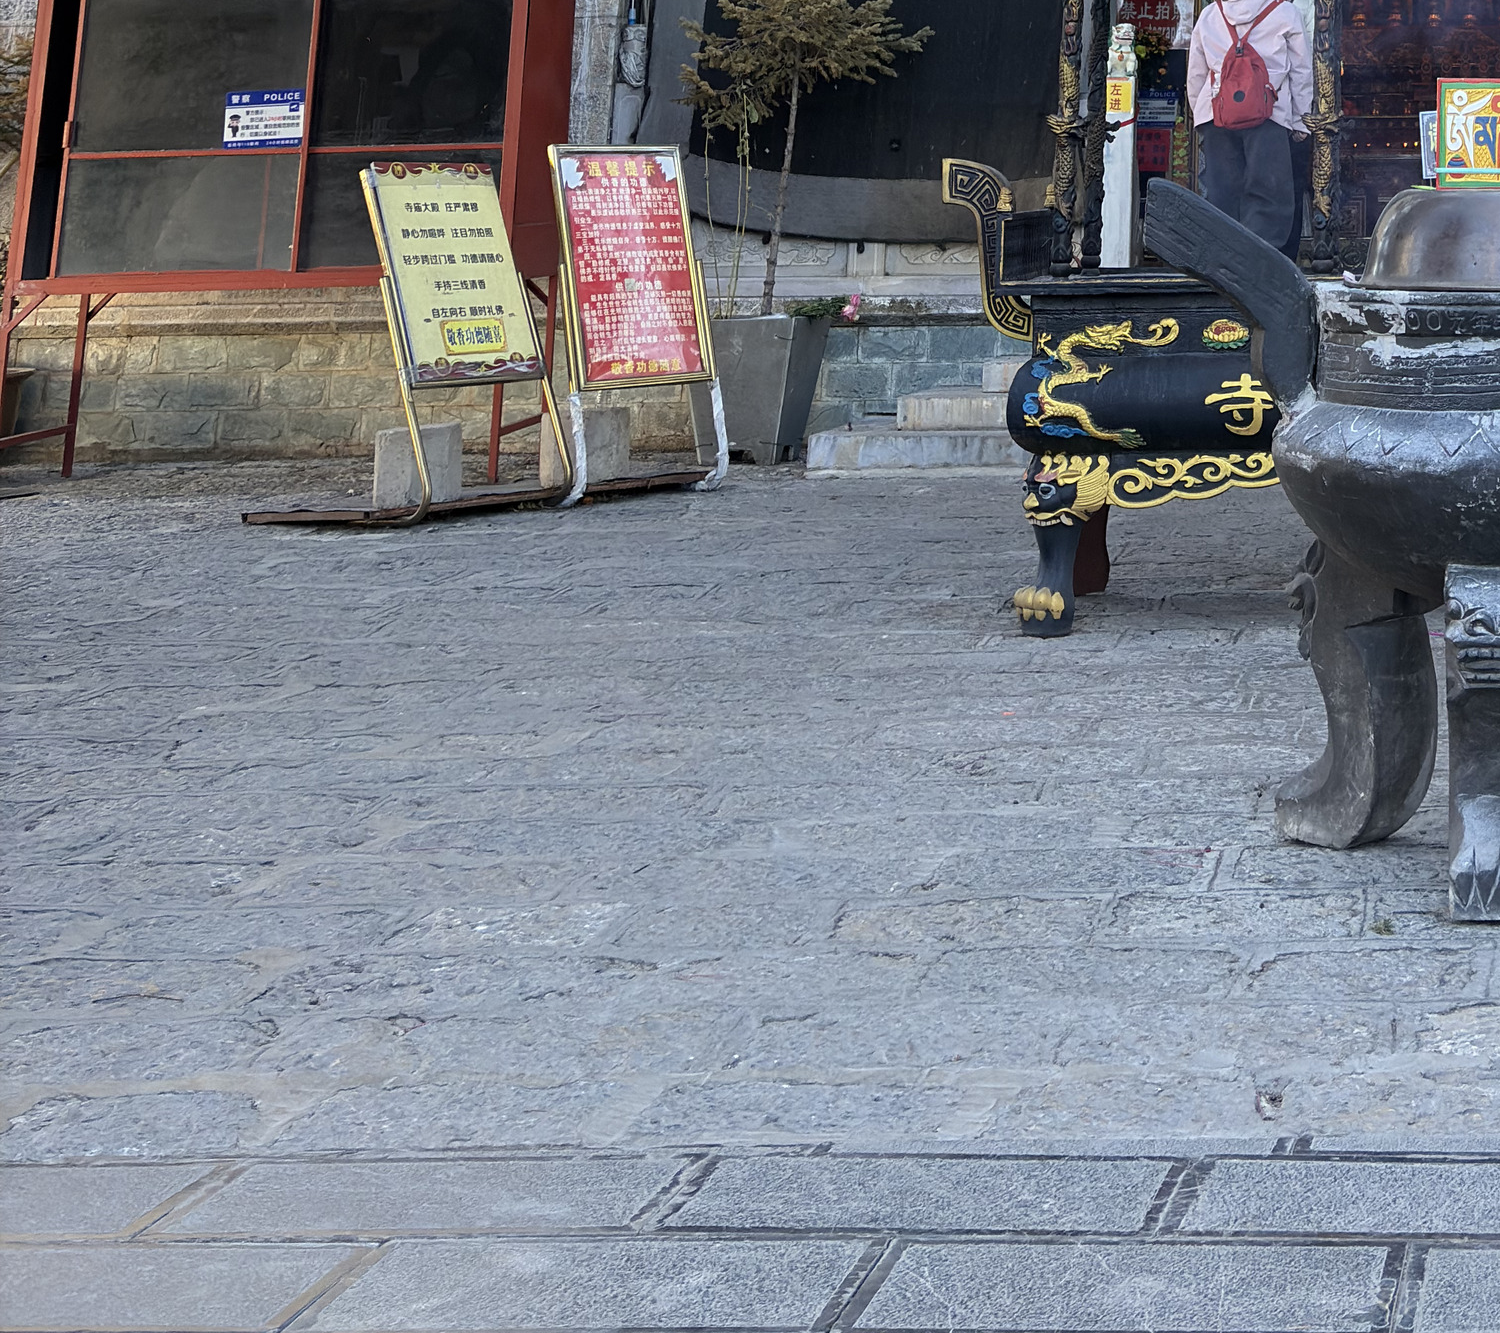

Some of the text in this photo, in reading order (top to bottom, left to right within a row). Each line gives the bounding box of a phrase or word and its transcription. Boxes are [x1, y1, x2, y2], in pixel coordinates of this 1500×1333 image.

[232, 93, 300, 104] 警察 POLICE
[1109, 84, 1122, 110] 左进
[587, 161, 655, 177] 温馨提示
[601, 178, 647, 187] 供香的功德
[404, 202, 479, 213] 寺庙大殿 庄严肃穆
[401, 227, 494, 239] 静心勿喧哗 注目勿拍照
[402, 253, 504, 265] 轻步跨过门槛 功德请随心
[434, 279, 486, 291] 手持三线清香
[615, 280, 663, 291] 供的功德
[431, 305, 504, 318] 自左向右 顺时礼佛
[446, 325, 502, 346] 敬香功德随喜
[1204, 373, 1274, 436] 寺
